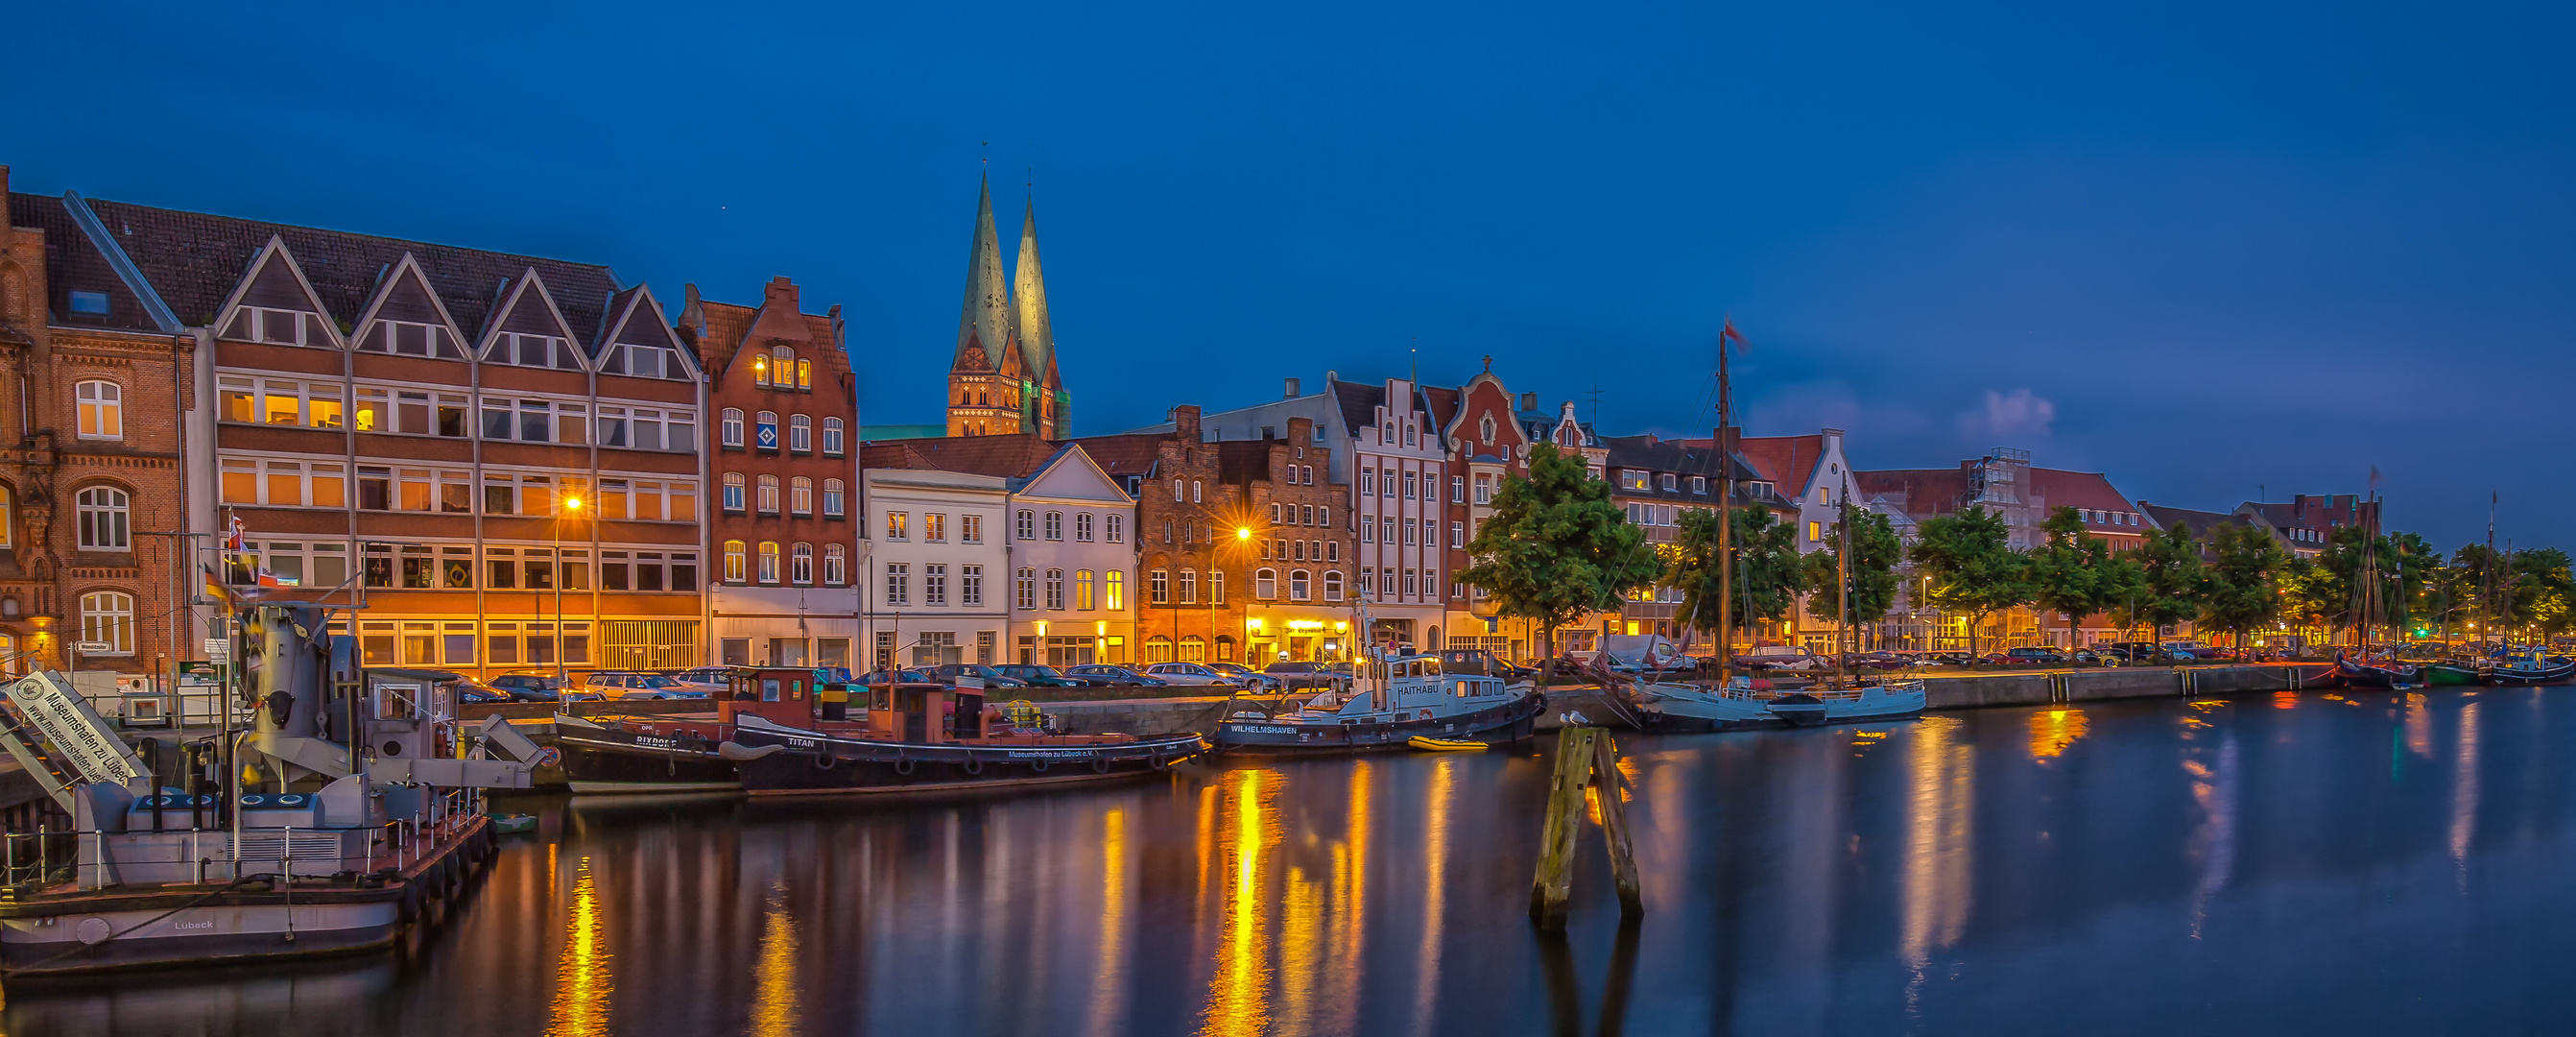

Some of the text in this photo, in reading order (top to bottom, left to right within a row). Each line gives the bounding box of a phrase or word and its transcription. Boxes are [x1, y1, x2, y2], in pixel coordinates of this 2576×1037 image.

[1397, 685, 1439, 695] HAITHABU
[1230, 725, 1298, 735] WILHELMSHAVEN
[44, 692, 129, 784] Museumshafen zu Lübec
[636, 736, 678, 748] RIXDORF
[788, 737, 814, 747] TITAN
[175, 921, 213, 929] Lübeck
